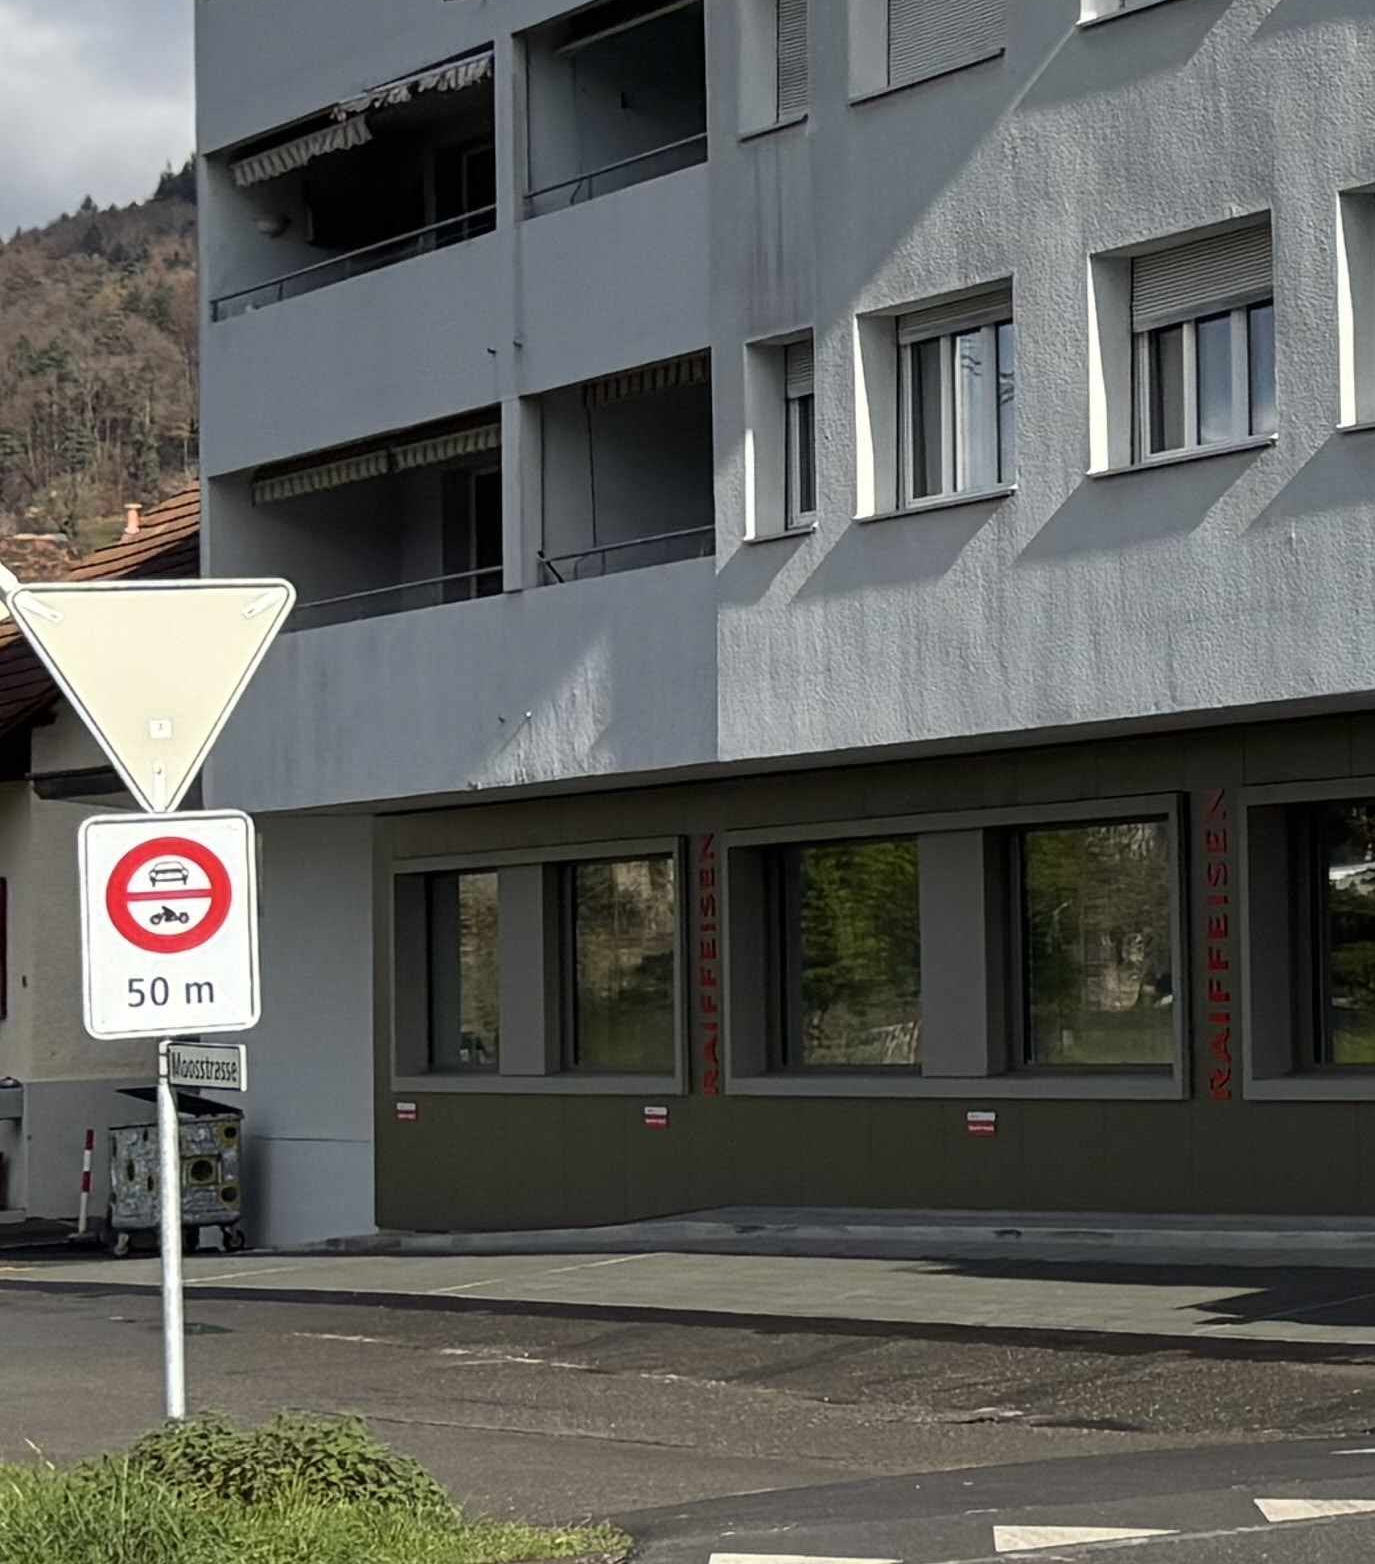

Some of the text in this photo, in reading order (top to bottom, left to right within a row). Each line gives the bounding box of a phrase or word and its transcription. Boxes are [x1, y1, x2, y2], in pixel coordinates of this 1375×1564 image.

[128, 976, 214, 1007] 50 m
[700, 833, 719, 1097] RAIFFEISEN
[1206, 788, 1232, 1101] RAIFFEISEN
[171, 1052, 237, 1082] Moosstrasse
